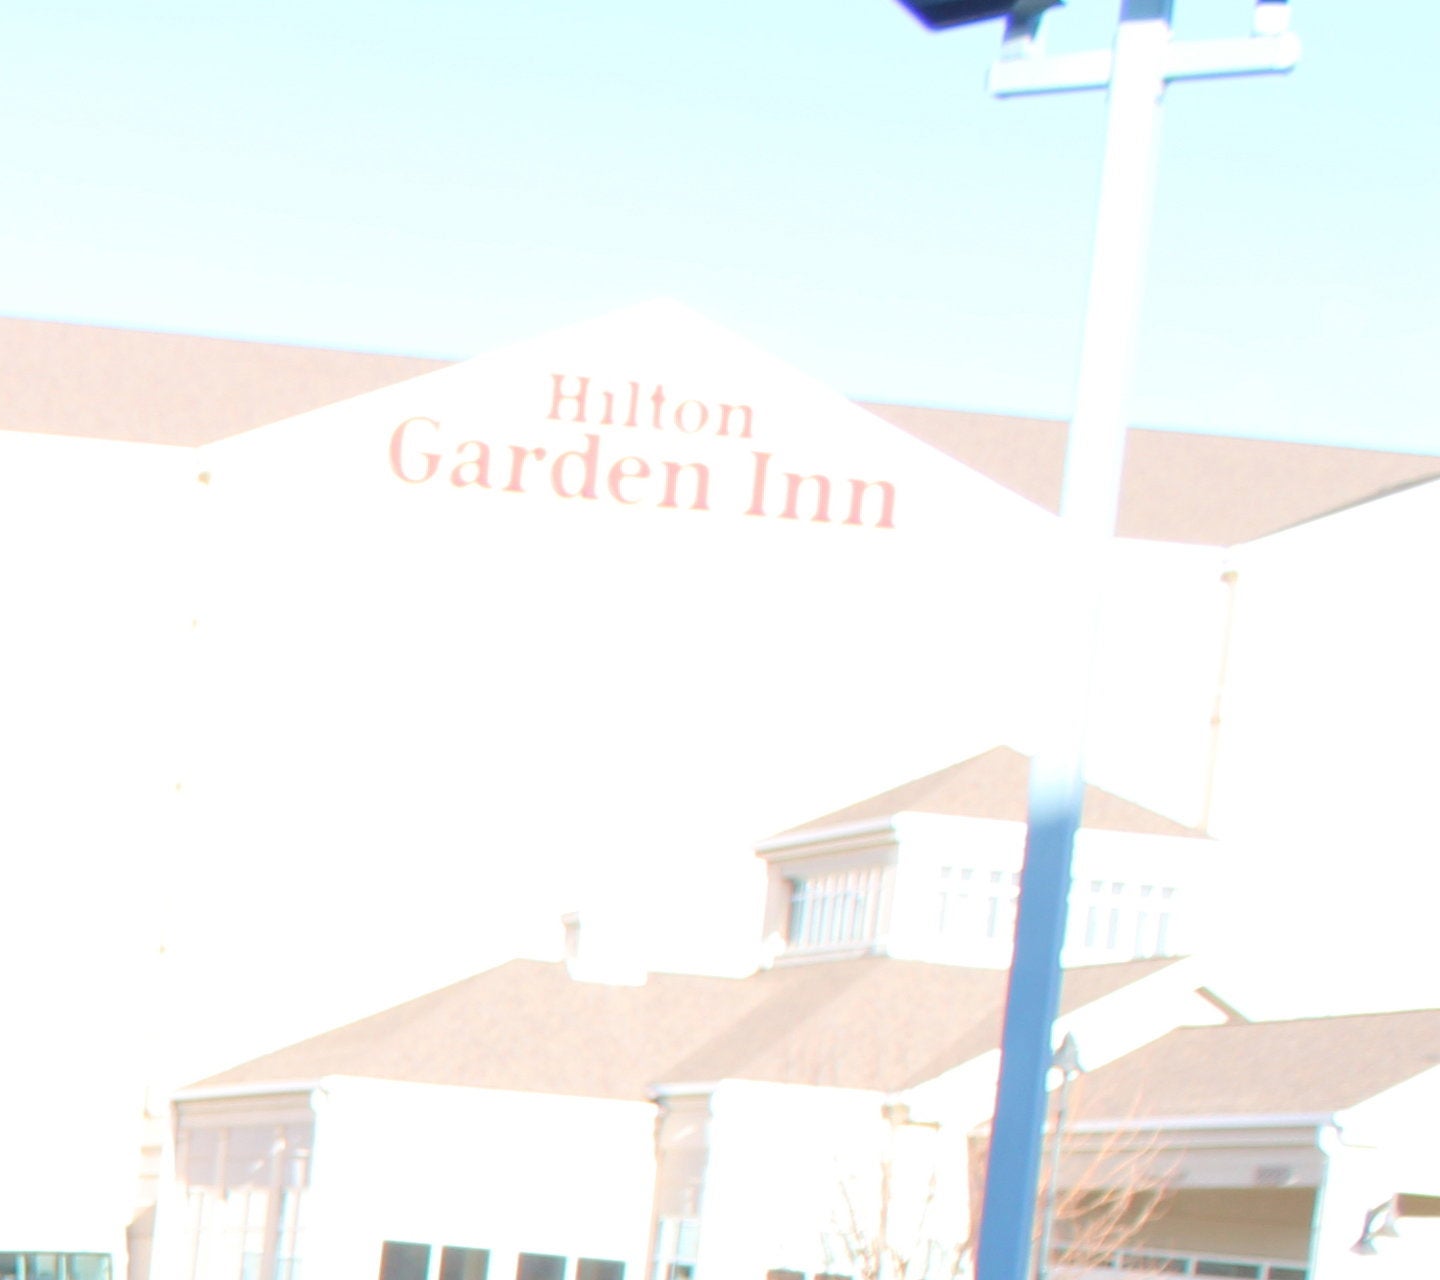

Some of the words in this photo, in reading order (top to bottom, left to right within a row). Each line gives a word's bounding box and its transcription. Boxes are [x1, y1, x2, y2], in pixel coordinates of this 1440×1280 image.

[546, 373, 755, 439] Hilton
[388, 416, 712, 512] Garden
[743, 450, 898, 530] Inn
